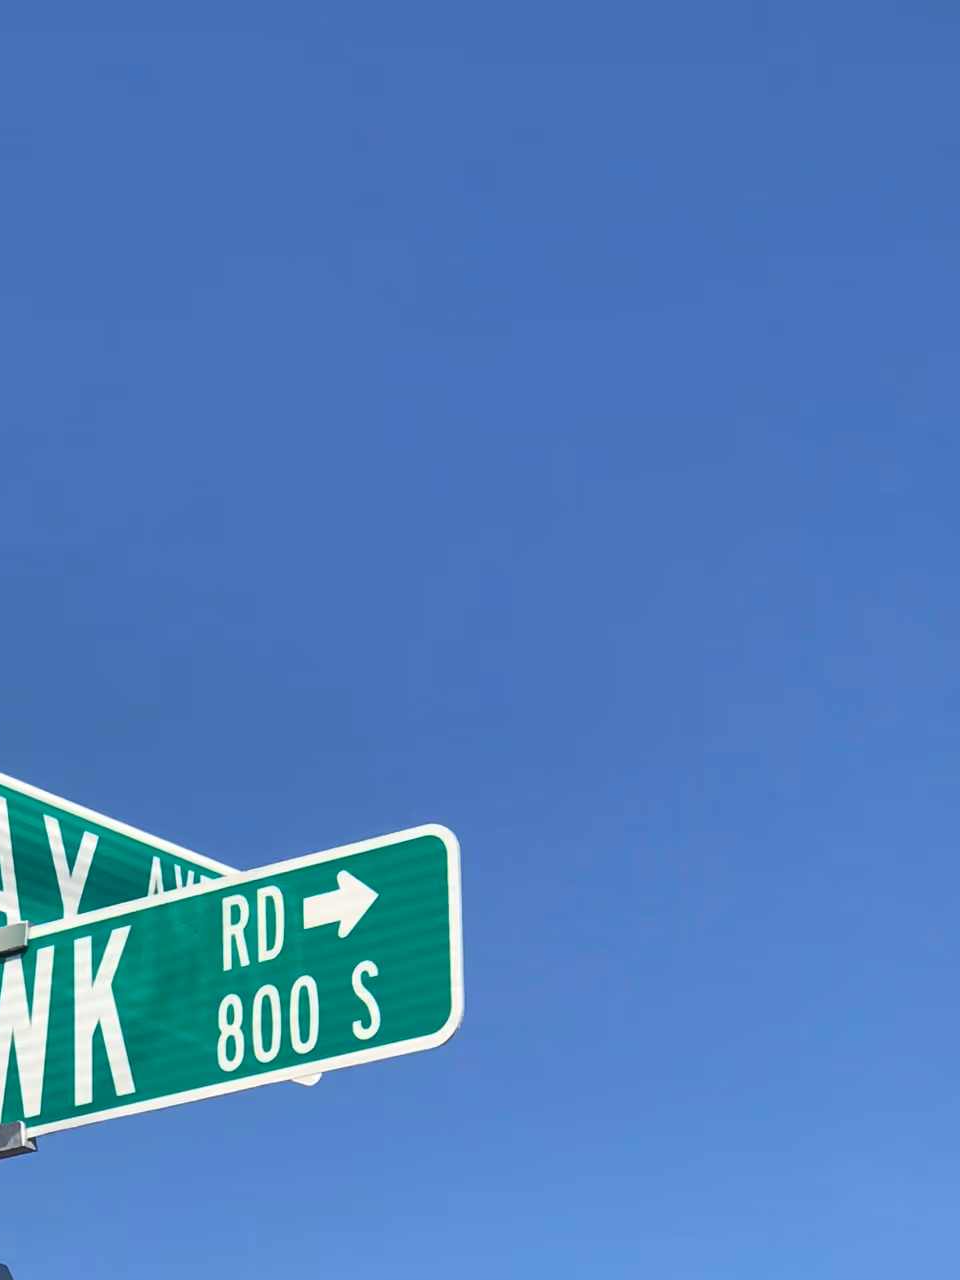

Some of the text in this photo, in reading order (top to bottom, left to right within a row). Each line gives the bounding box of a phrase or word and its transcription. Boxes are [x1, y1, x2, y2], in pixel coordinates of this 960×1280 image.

[222, 885, 285, 972] RD
[217, 959, 382, 1072] 800 S
